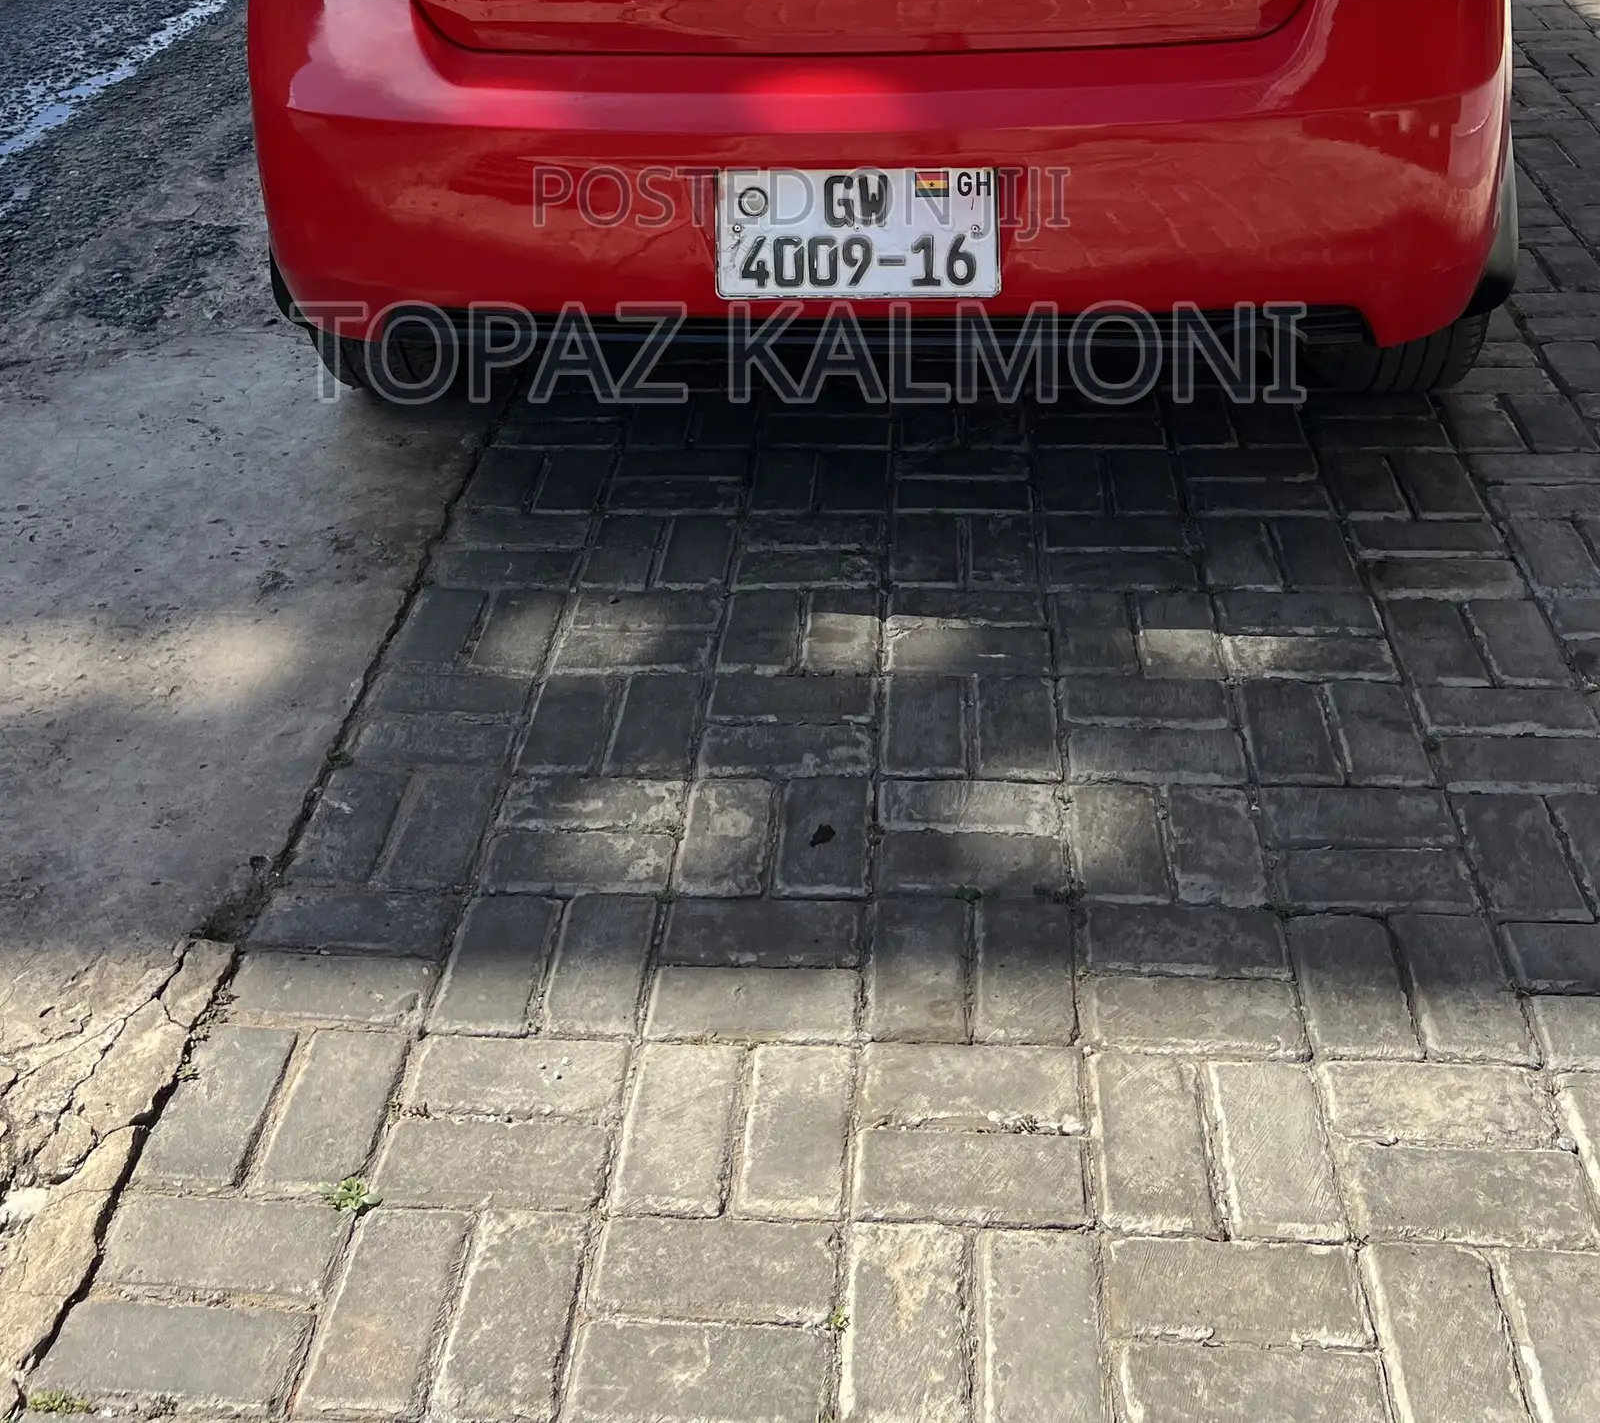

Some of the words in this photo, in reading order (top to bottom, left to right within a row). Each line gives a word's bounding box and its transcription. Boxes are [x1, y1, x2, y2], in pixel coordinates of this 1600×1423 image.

[823, 174, 890, 228] GW
[956, 170, 992, 197] GH
[740, 234, 978, 288] 4009-16
